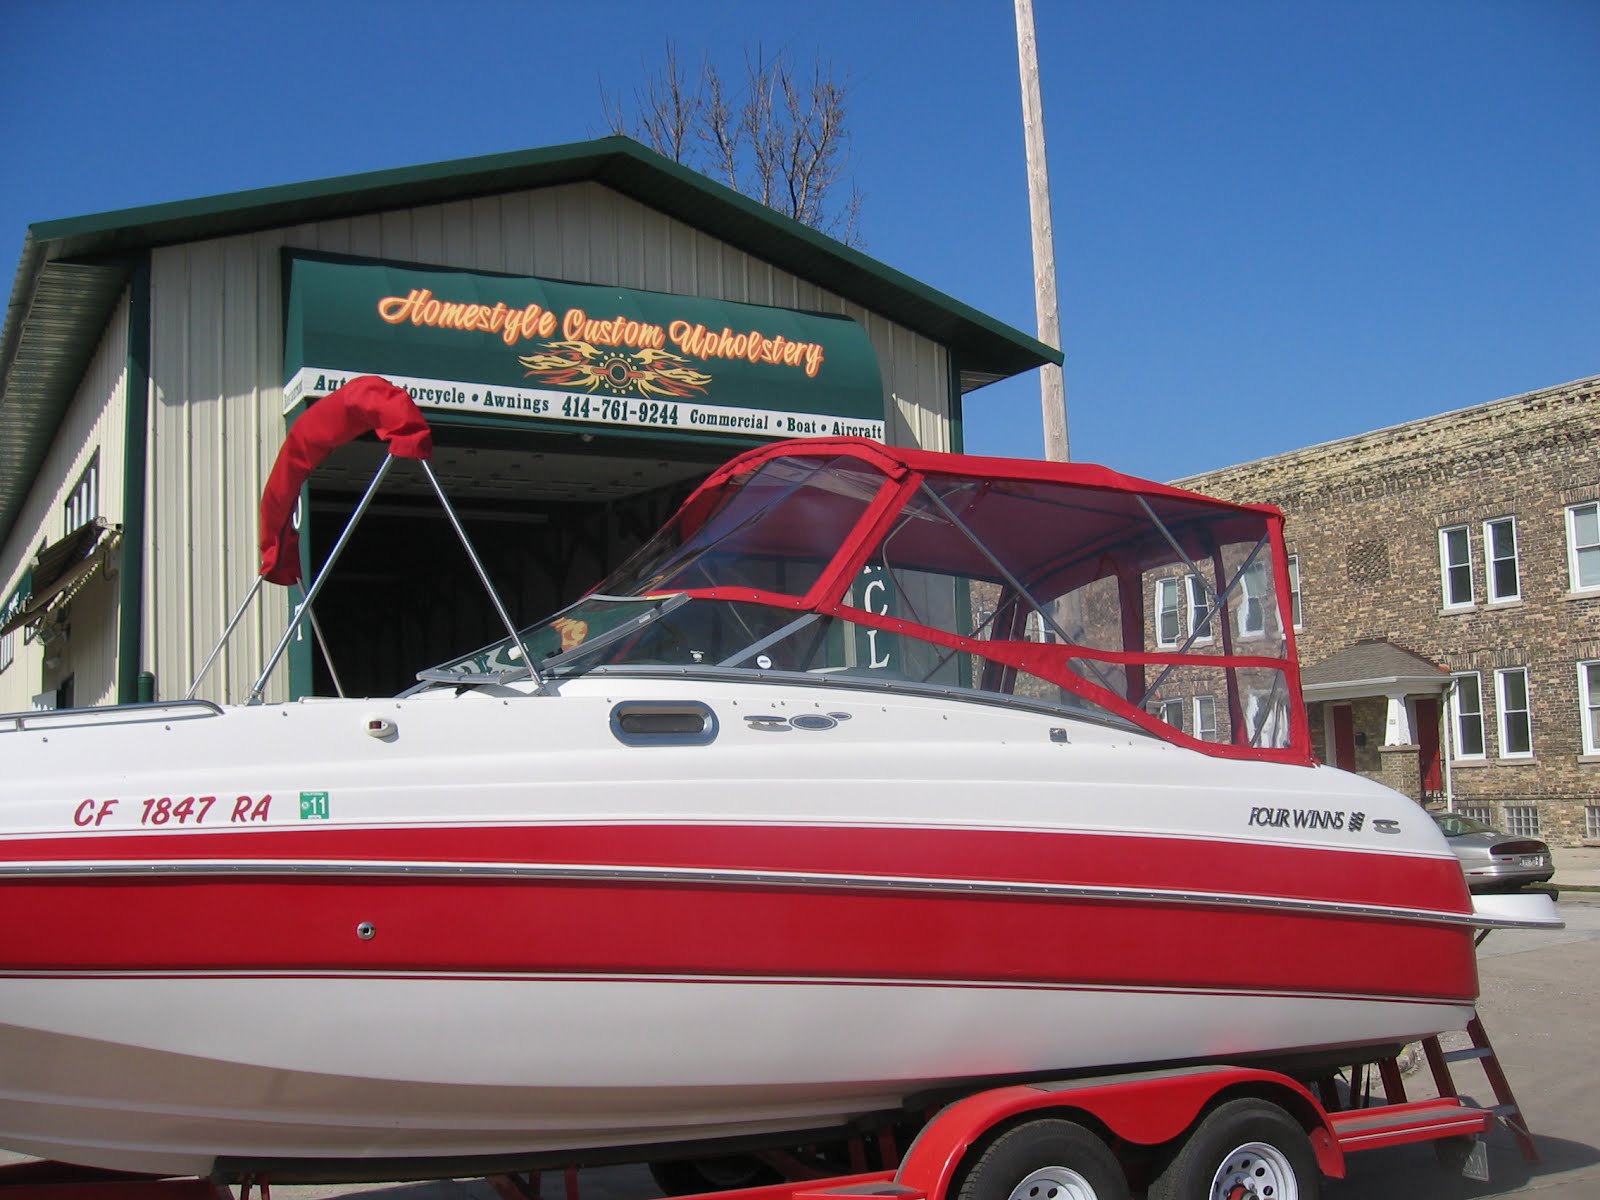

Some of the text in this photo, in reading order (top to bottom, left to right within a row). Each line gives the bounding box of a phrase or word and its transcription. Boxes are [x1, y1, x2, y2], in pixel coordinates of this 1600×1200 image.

[378, 288, 825, 378] Homestyle Custom Upholstery
[313, 374, 347, 392] Aut
[483, 390, 550, 414] Awnings
[561, 395, 679, 425] 414-761-9244
[689, 409, 769, 430] Commercial
[786, 417, 817, 434] Boat
[832, 421, 882, 439] Aircraft
[74, 794, 272, 826] CF 1847 RA
[310, 796, 326, 815] 11
[1248, 807, 1345, 830] FOUR WINNS
